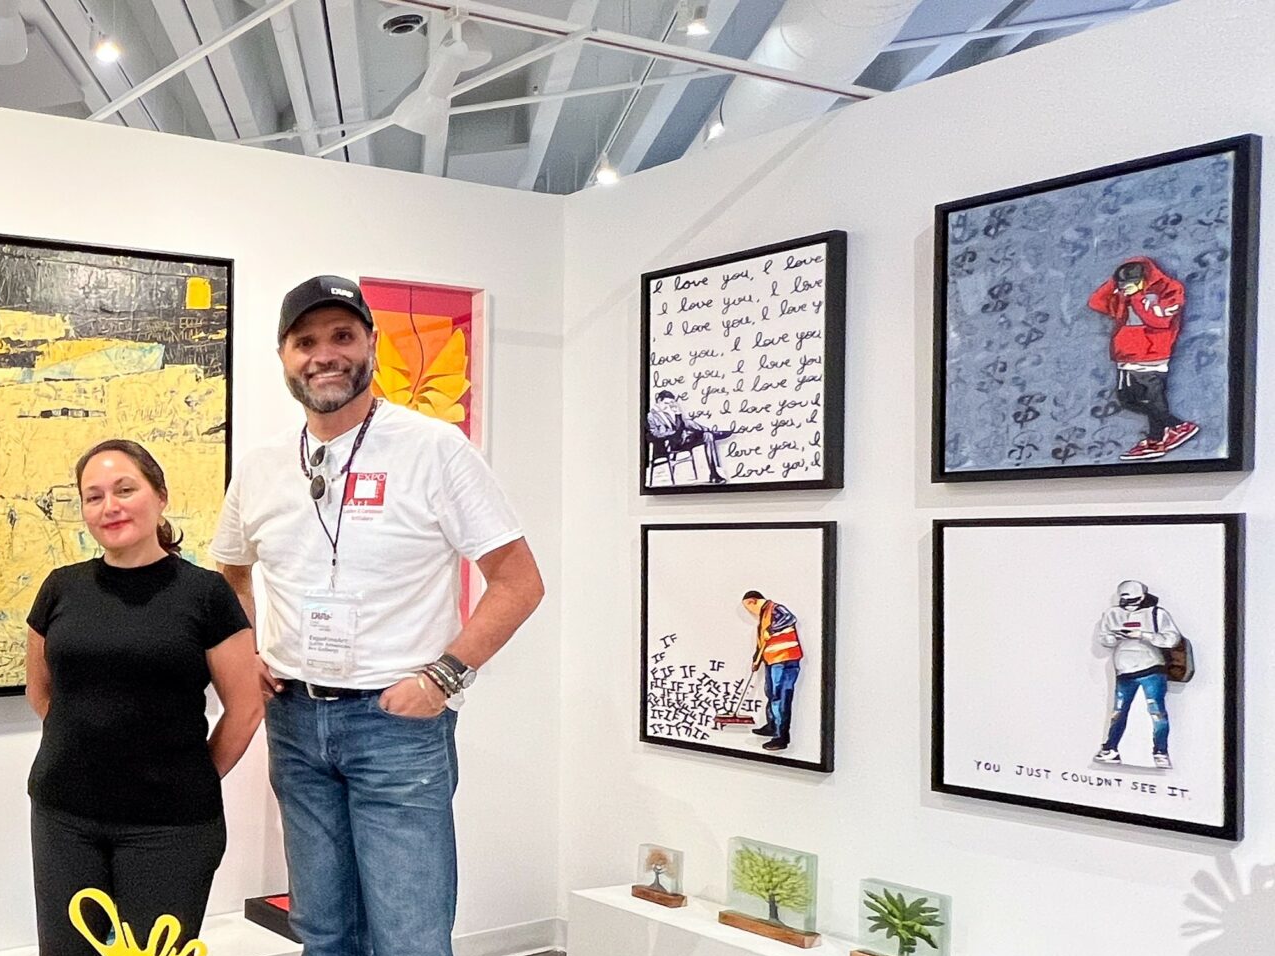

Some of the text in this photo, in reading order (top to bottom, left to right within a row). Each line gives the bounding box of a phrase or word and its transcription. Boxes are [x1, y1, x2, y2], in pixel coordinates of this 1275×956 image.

[660, 633, 677, 649] IF
[651, 652, 666, 664] IF
[679, 665, 696, 678] IF
[709, 660, 725, 672] IF
[974, 760, 1001, 773] YOU
[1015, 765, 1051, 779] JUST
[1061, 771, 1123, 787] COULDNT
[1131, 782, 1157, 794] SEE
